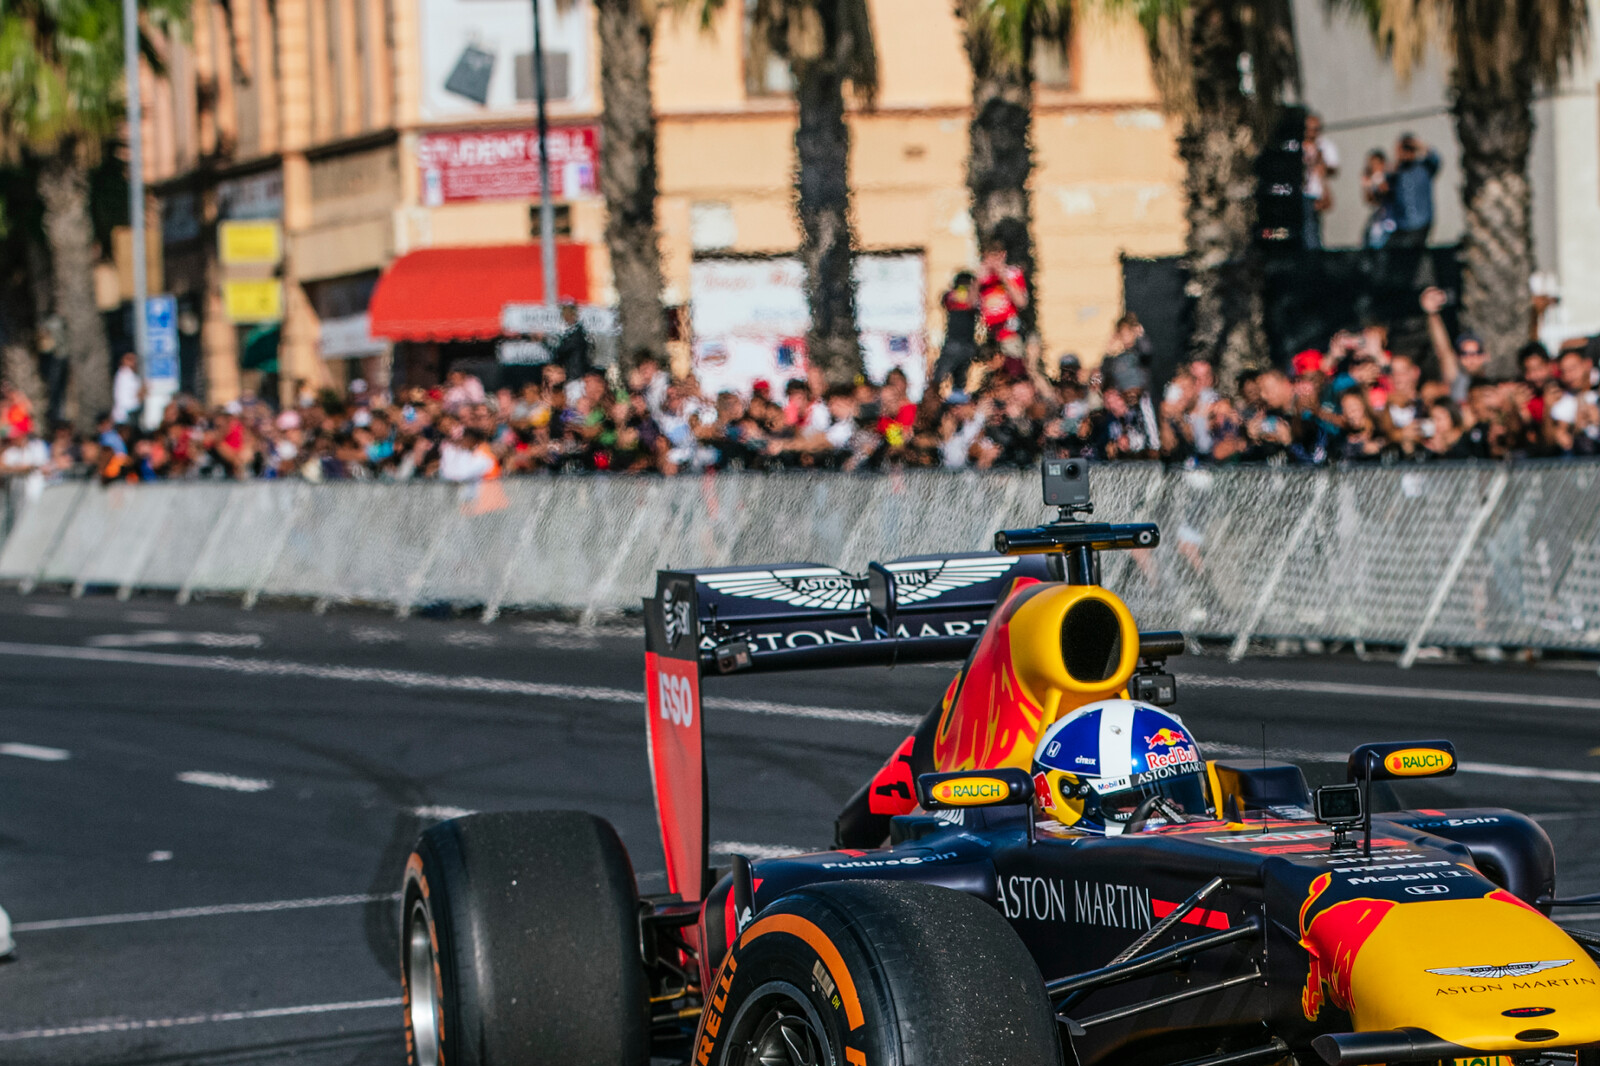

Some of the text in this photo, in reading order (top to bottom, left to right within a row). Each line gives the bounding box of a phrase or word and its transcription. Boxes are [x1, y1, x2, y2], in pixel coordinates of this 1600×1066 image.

[797, 577, 852, 592] ASTON
[1145, 747, 1178, 770] Red
[1403, 755, 1443, 768] RAUCH
[1138, 765, 1177, 784] ASTON
[953, 784, 1000, 798] RAUCH
[1098, 780, 1118, 791] Mobil
[1347, 872, 1438, 886] Mobil
[998, 875, 1151, 931] ASTON MARTIN
[1436, 977, 1596, 997] ASTON MARTIN
